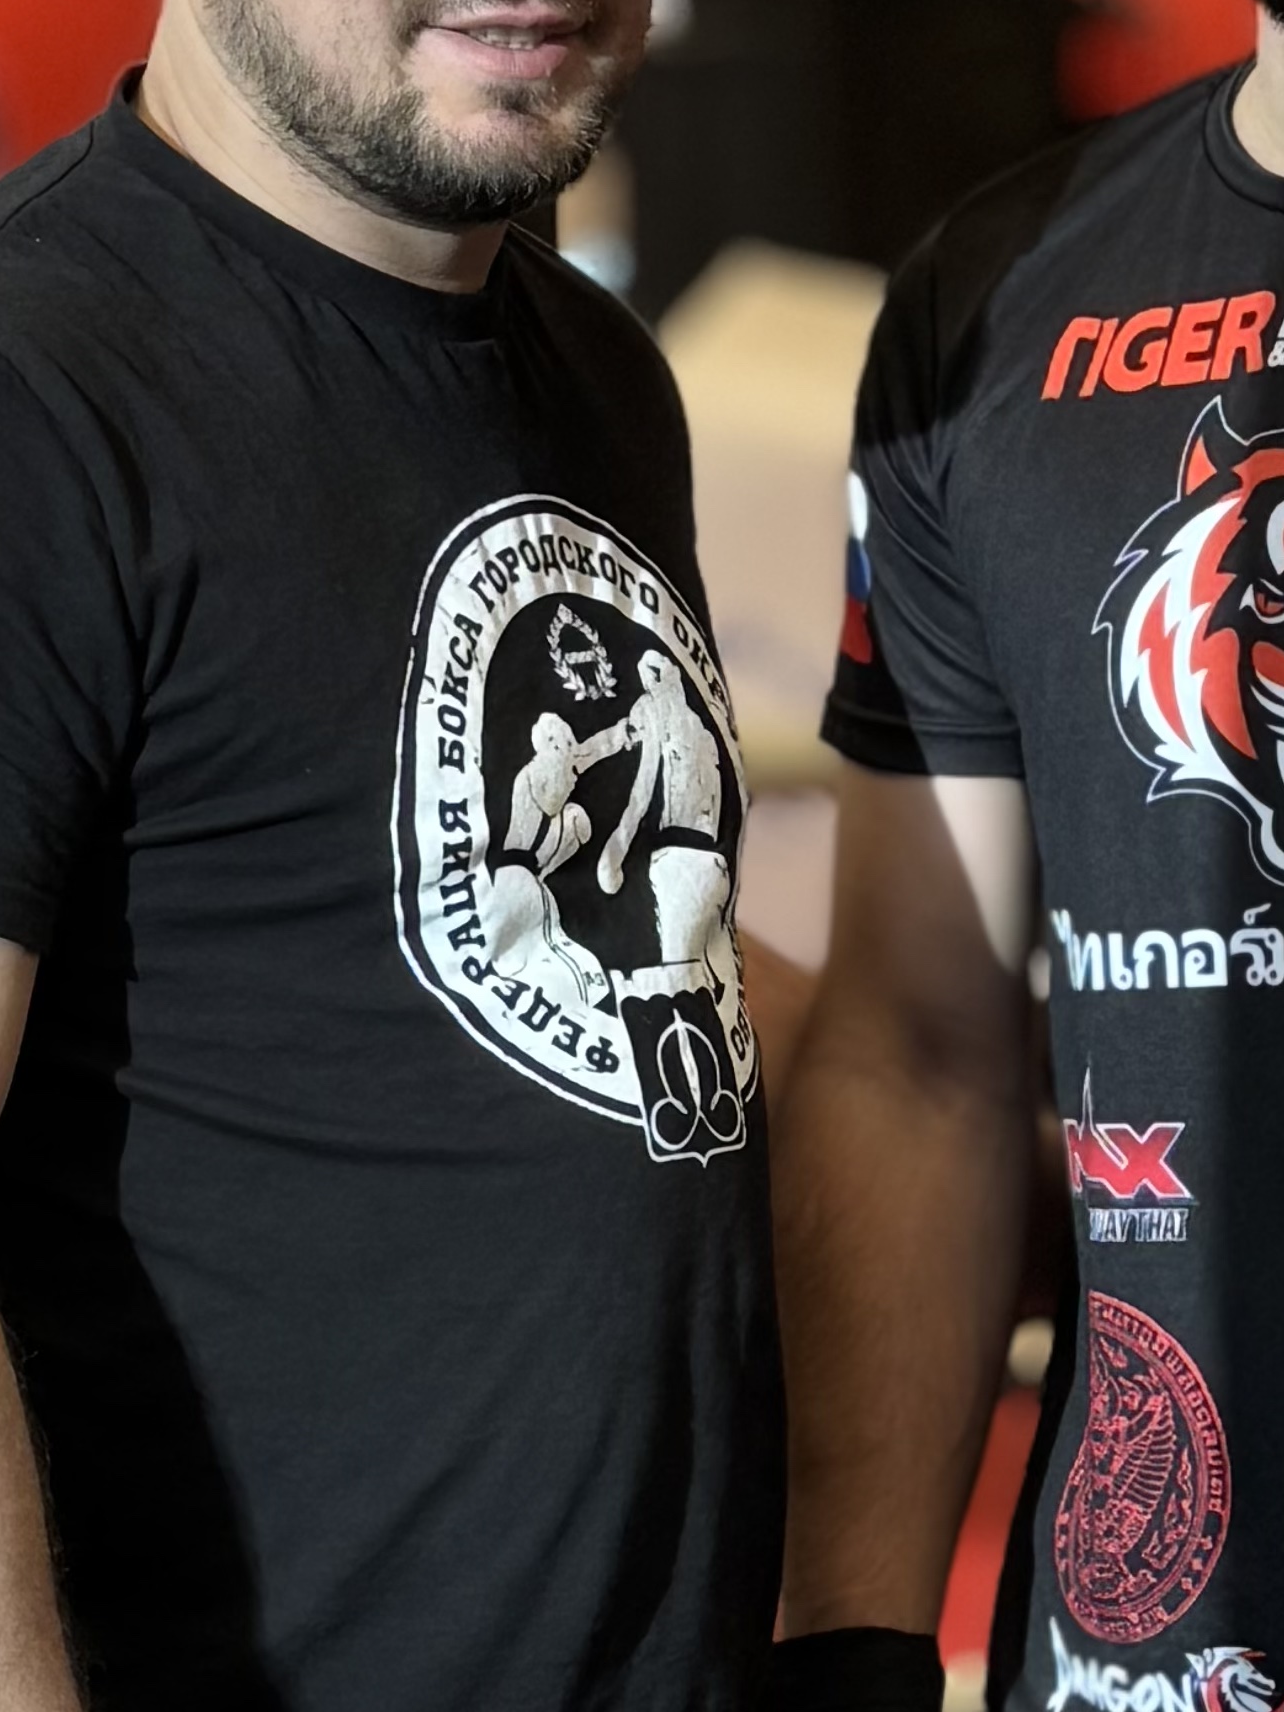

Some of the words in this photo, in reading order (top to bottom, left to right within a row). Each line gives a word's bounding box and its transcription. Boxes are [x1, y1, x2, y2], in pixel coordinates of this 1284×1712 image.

[1041, 290, 1276, 401] TIGER
[468, 533, 659, 614] ГОРОДСКОГО
[436, 612, 484, 776] БОКСА
[437, 797, 621, 1074] ФЕДЕРАЦИЯ
